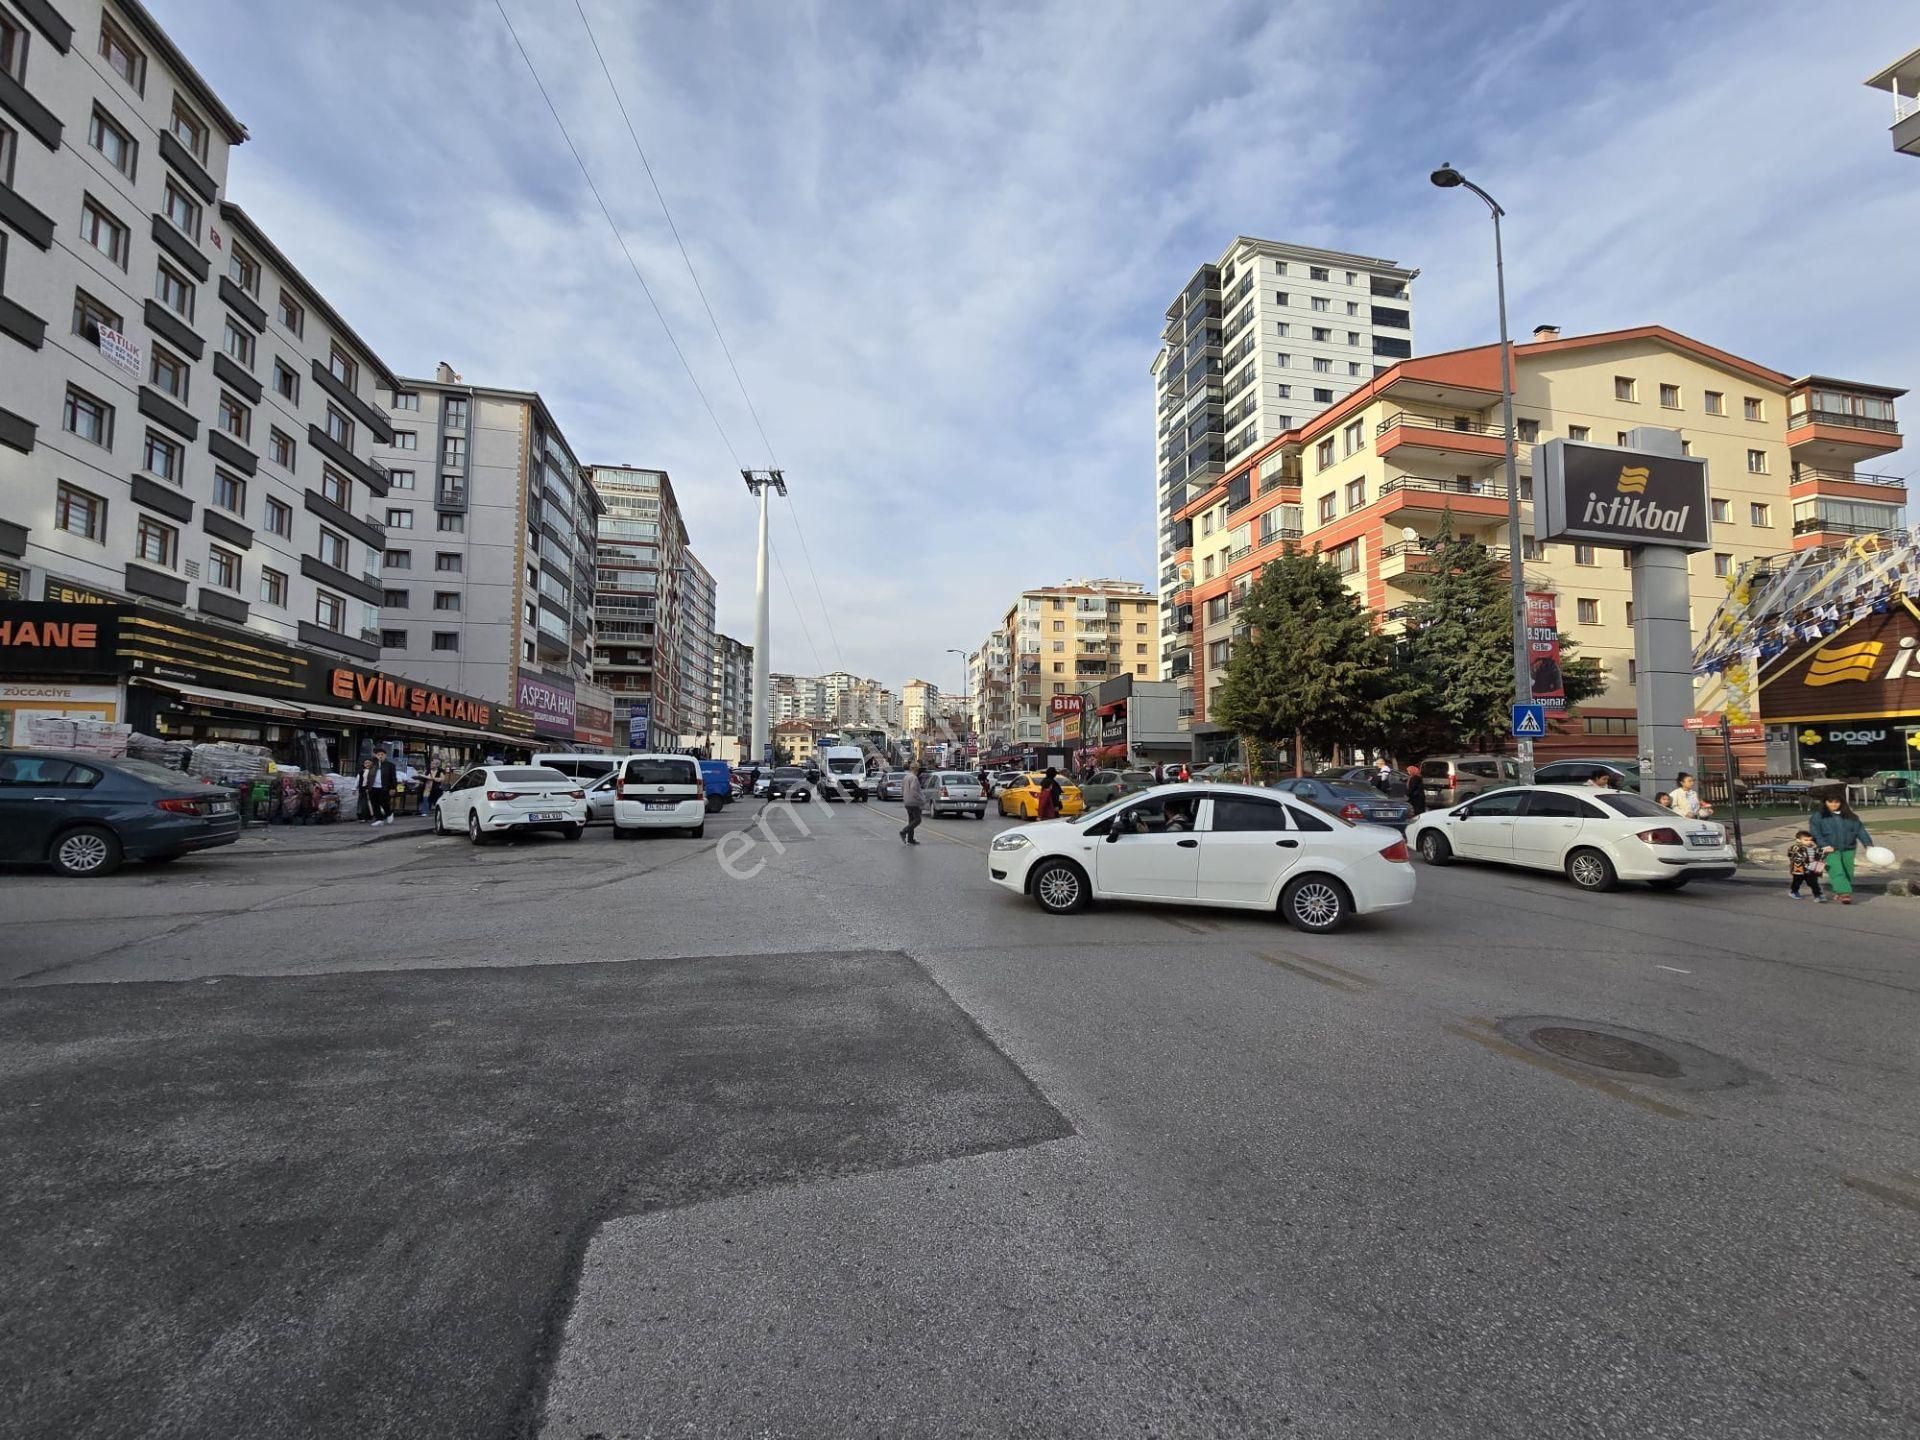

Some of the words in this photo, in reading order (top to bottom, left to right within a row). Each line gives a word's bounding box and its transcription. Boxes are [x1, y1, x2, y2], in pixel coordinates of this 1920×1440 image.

[100, 325, 140, 358] SATILIK
[1583, 492, 1689, 533] istikbal
[3, 687, 72, 698] ZÜCCACİYE
[333, 668, 406, 709] EVİM
[411, 687, 489, 725] ŞAHANE
[520, 684, 557, 710] ASPERA
[1054, 696, 1080, 710] BİM
[1829, 730, 1886, 742] DOQU
